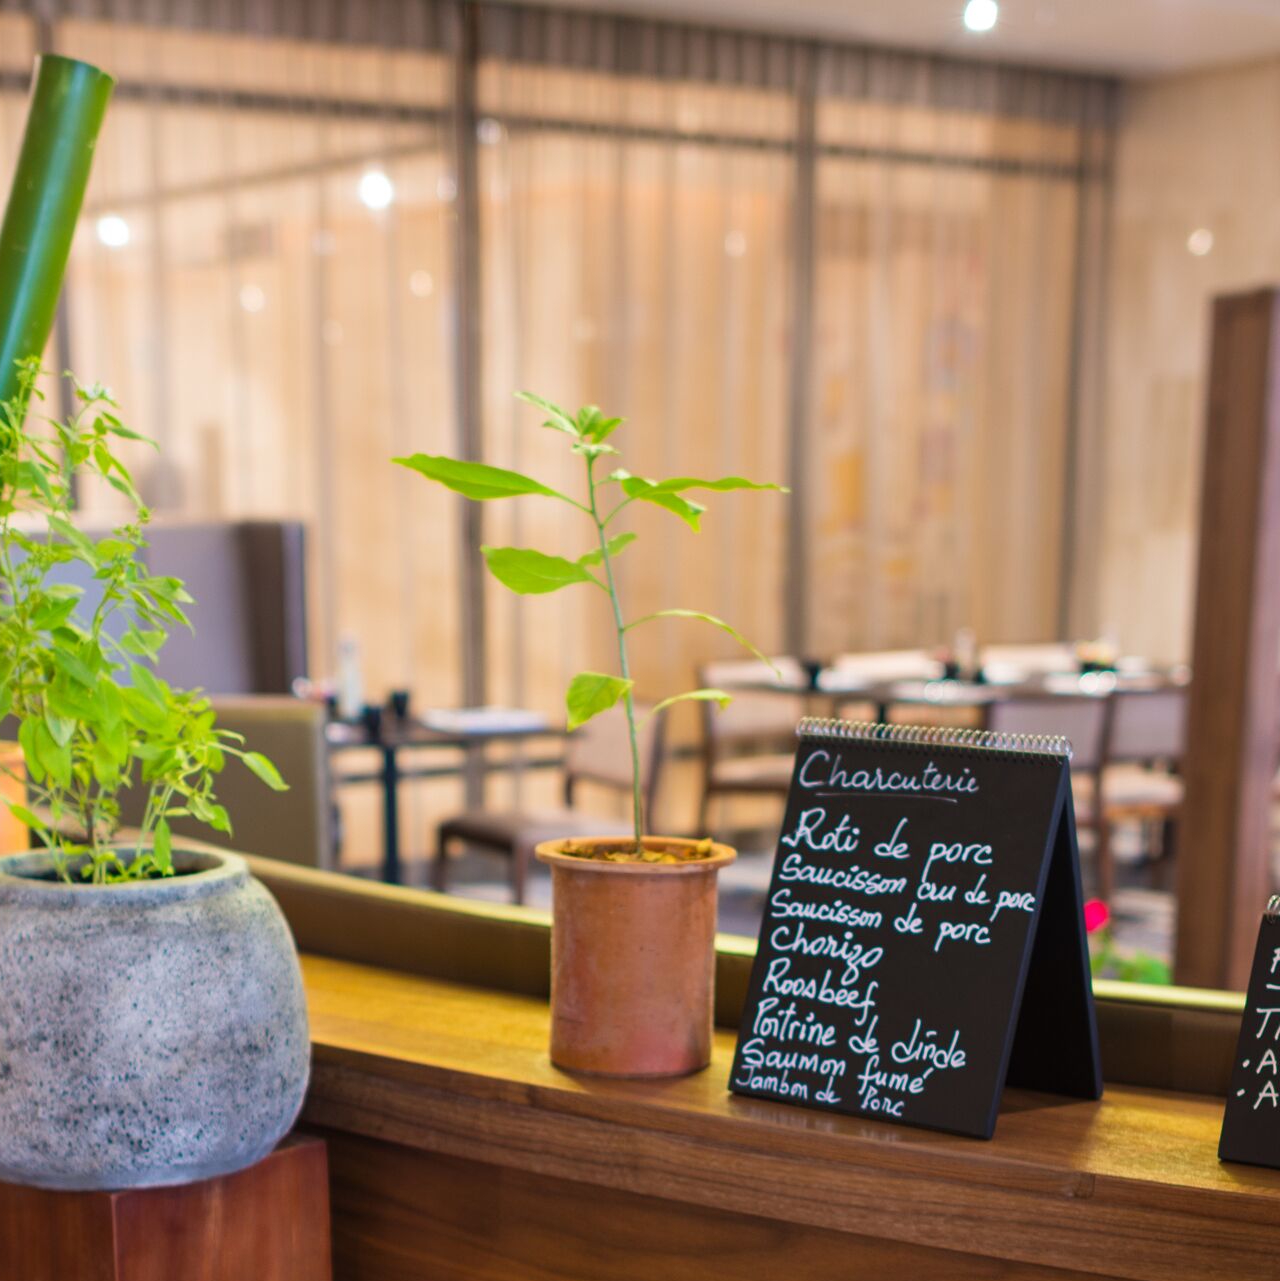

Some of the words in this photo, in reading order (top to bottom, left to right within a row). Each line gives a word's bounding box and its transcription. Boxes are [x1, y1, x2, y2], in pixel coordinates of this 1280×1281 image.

[798, 749, 981, 794] Charcuterie
[874, 817, 911, 860] de
[921, 841, 994, 884] porc
[778, 854, 908, 896] Saucisson
[964, 873, 991, 905] de
[988, 890, 1036, 922] porc
[770, 887, 883, 929] Saucisson
[893, 902, 924, 934] de
[933, 921, 992, 953] porc
[770, 921, 884, 987] Chorizo
[752, 996, 837, 1047] Poitrine
[848, 1013, 880, 1054] de
[891, 1018, 967, 1069] dinde
[1255, 1048, 1278, 1075] A
[735, 1064, 808, 1100] Jambon
[814, 1075, 842, 1104] de
[860, 1085, 905, 1118] Porc
[741, 1037, 847, 1077] Saumon
[856, 1054, 935, 1096] fumé
[1253, 1080, 1279, 1110] A
